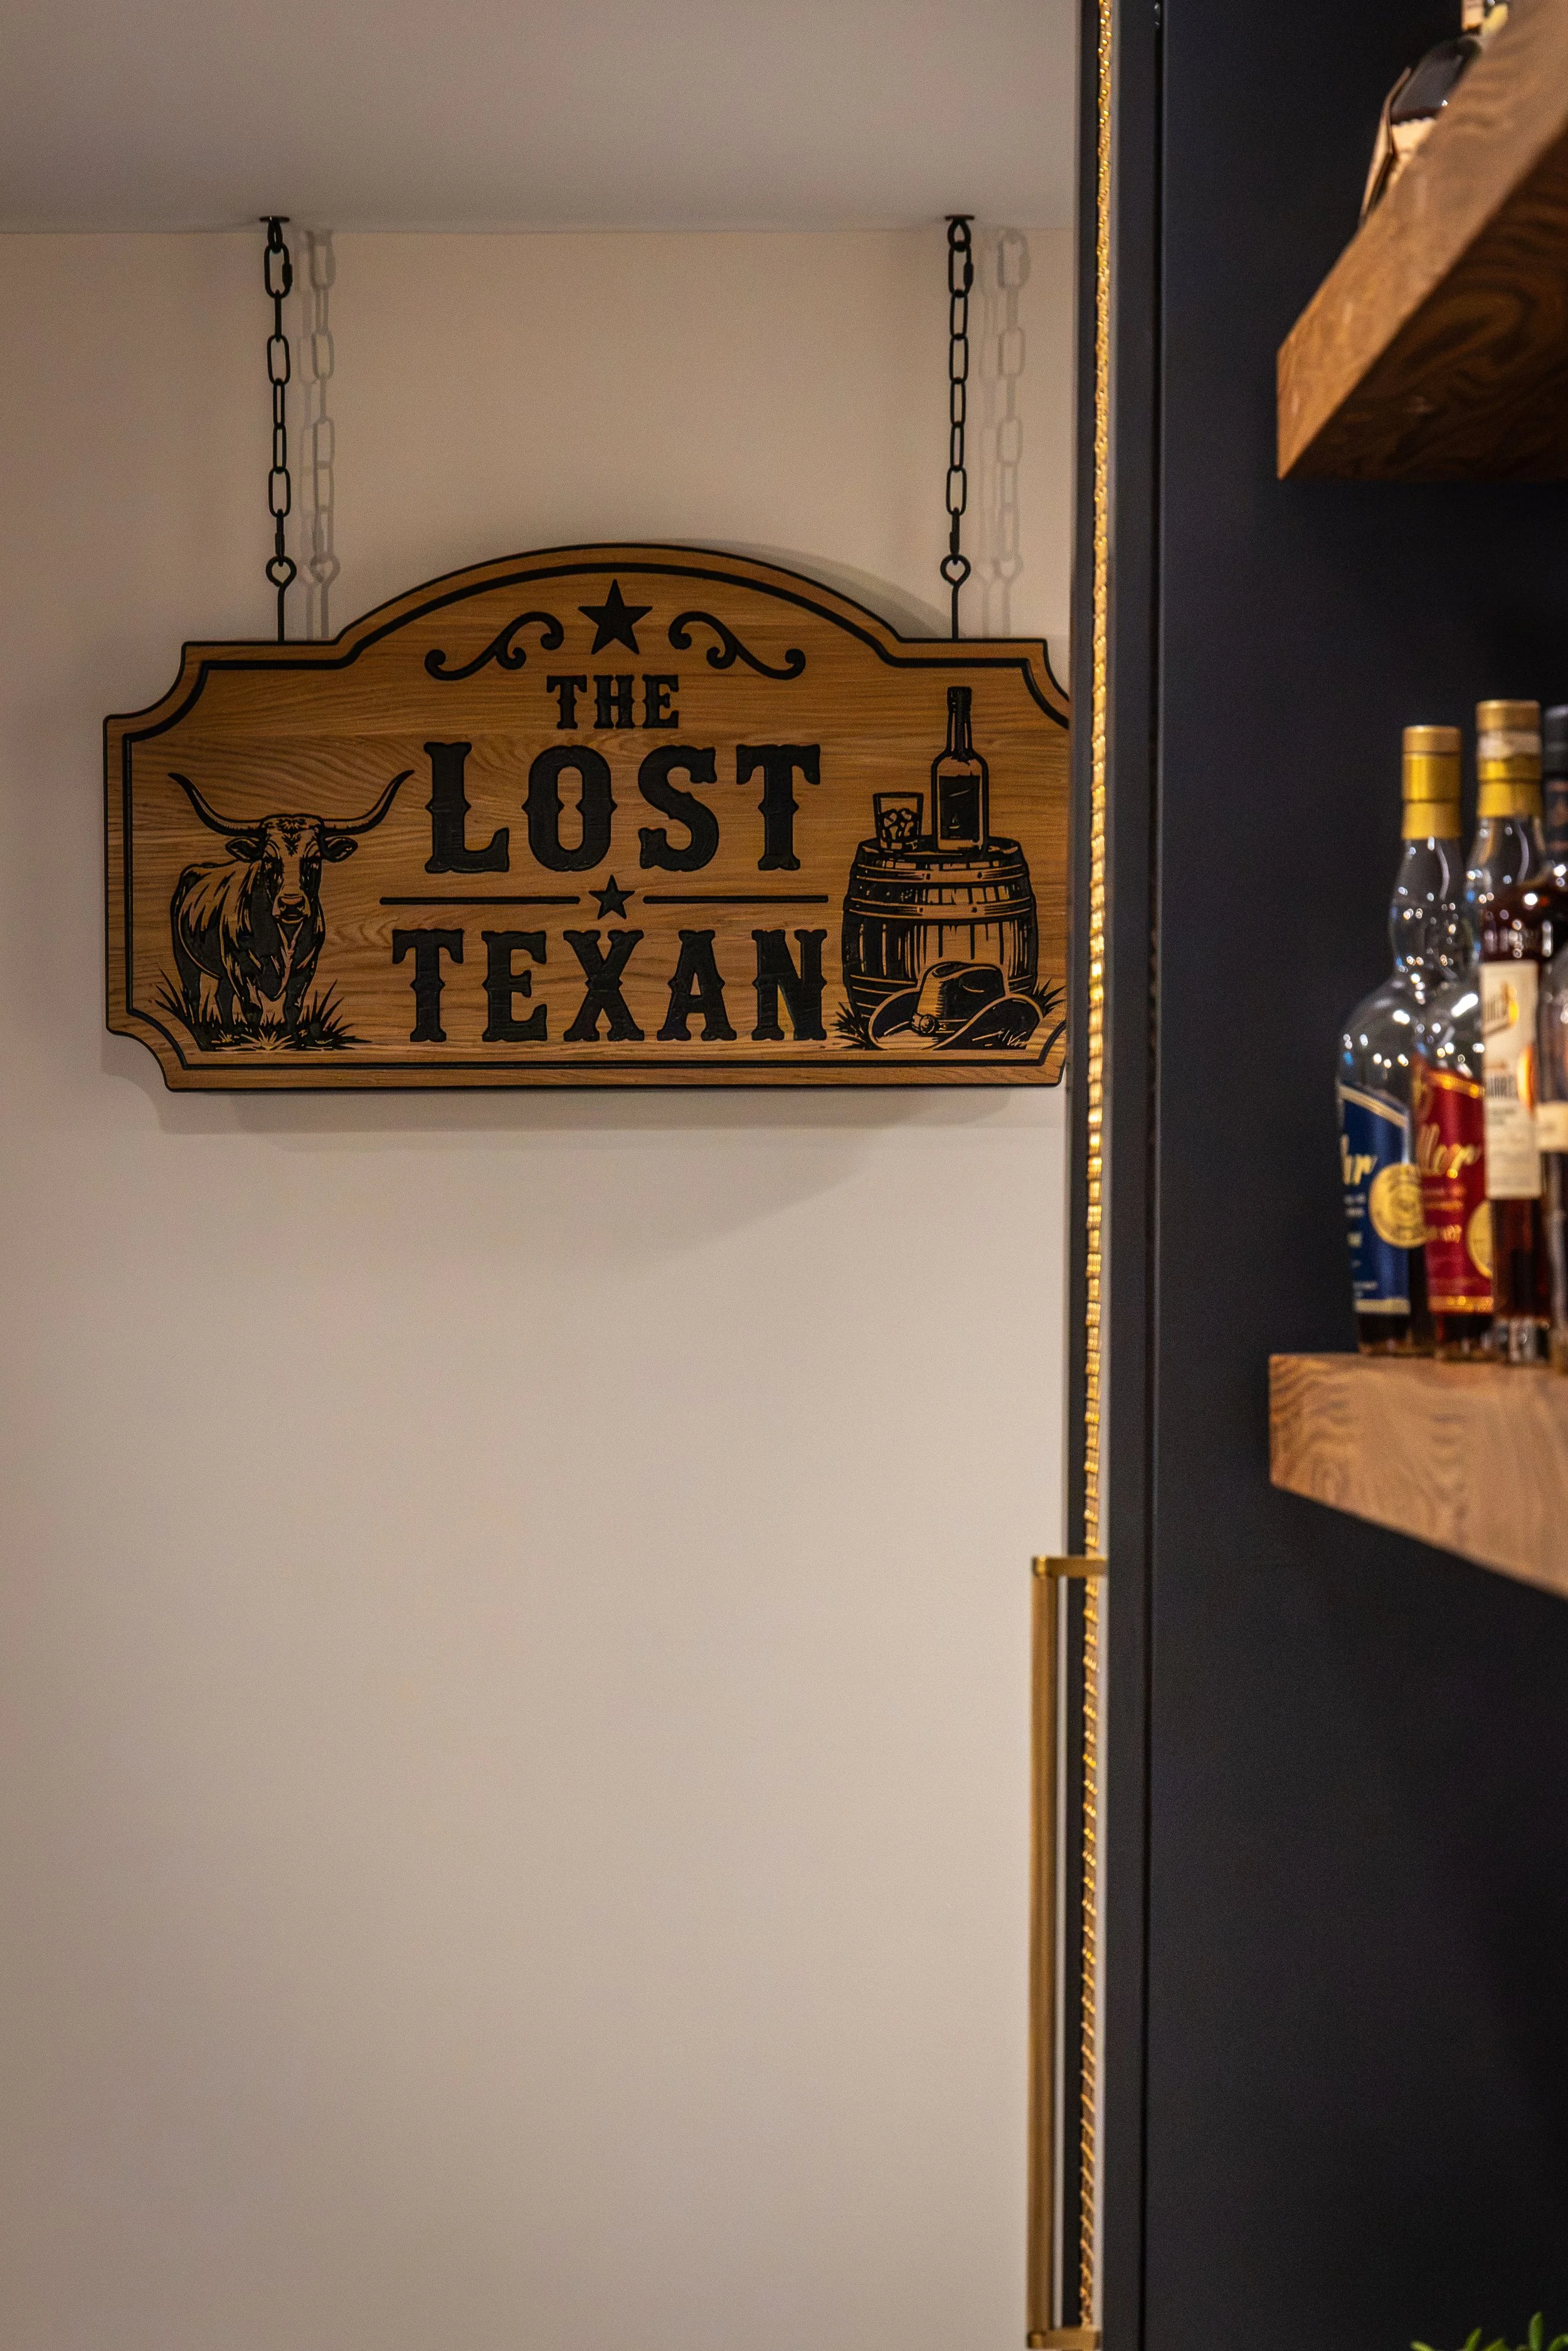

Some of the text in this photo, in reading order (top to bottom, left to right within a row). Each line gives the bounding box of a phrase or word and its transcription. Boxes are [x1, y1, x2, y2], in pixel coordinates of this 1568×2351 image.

[546, 674, 679, 730] THE
[423, 741, 820, 874] LOST
[392, 928, 827, 1042] TEXAN
